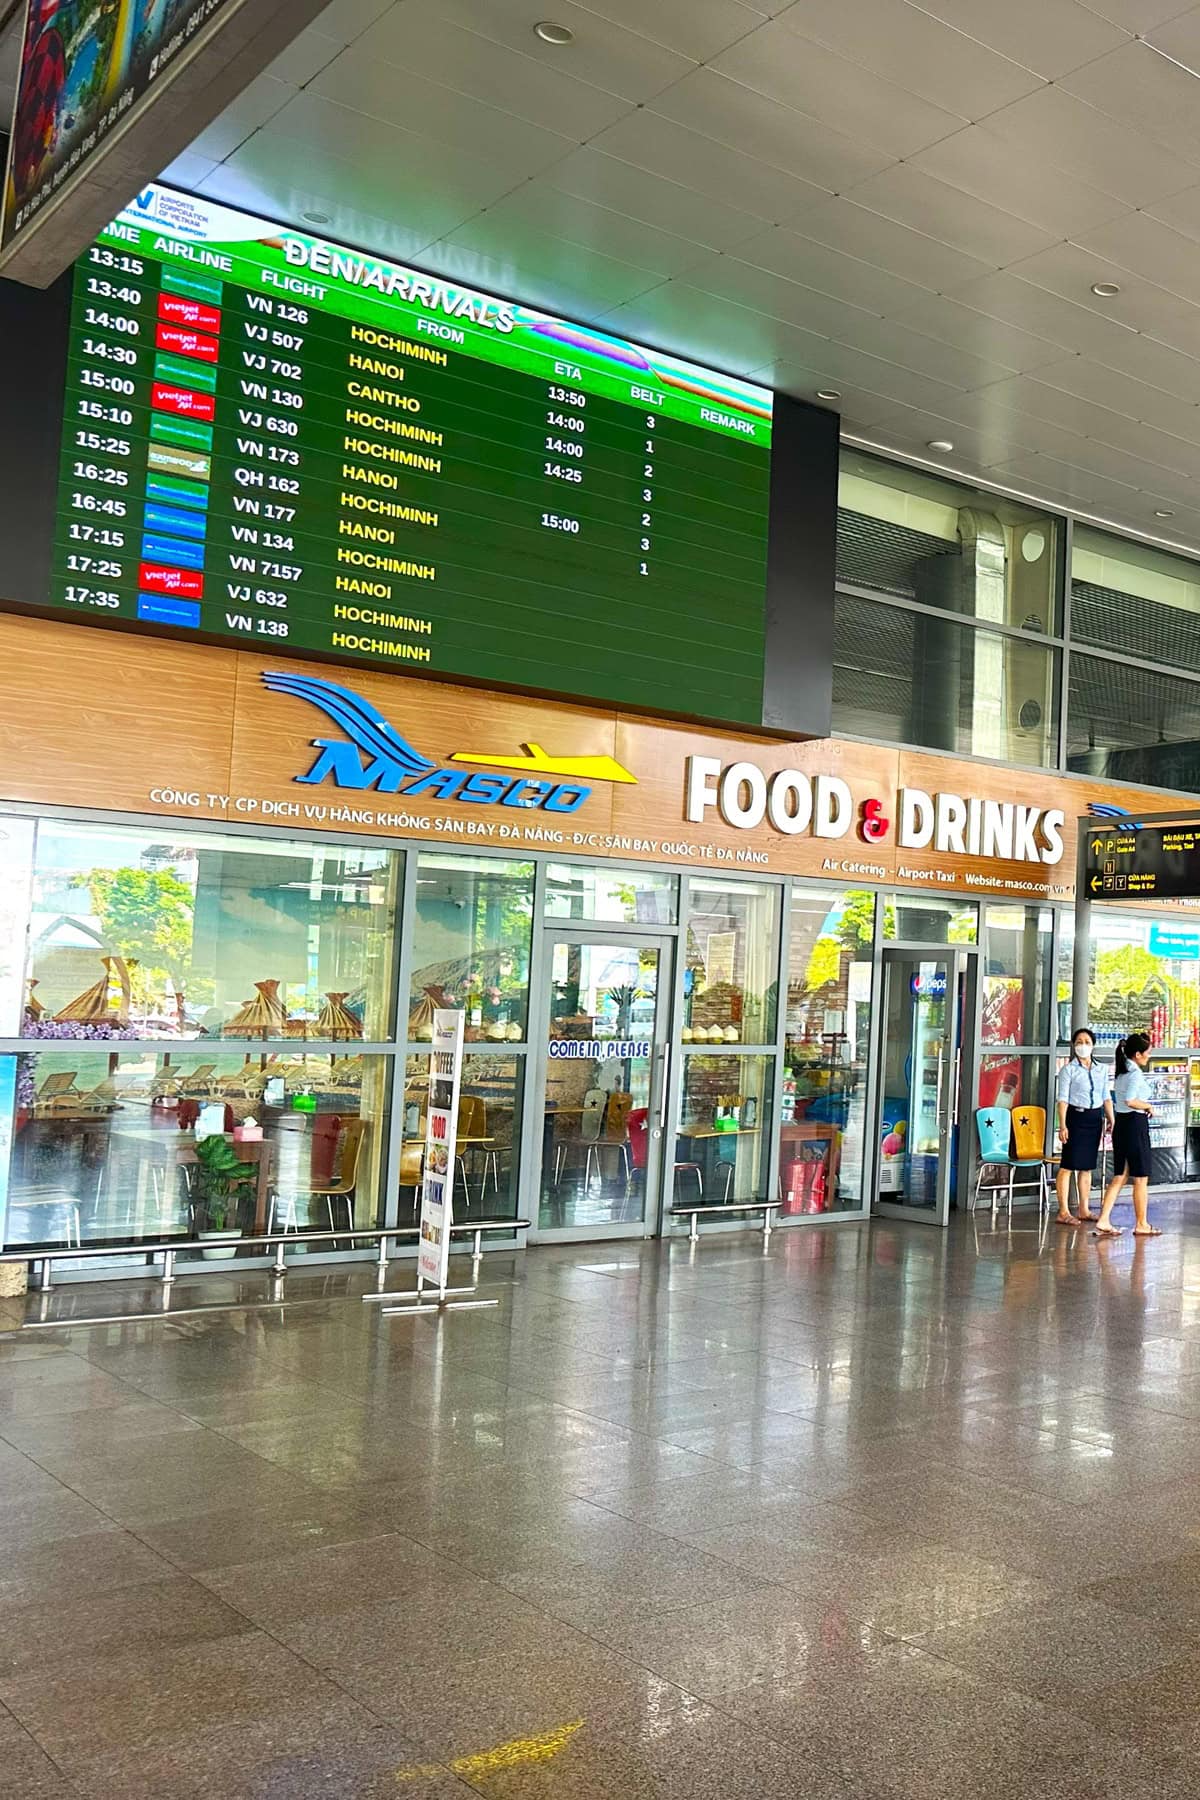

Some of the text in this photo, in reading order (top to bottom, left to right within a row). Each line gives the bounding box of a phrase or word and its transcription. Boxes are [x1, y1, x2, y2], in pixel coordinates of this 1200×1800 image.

[158, 209, 169, 217] OF
[160, 202, 208, 223] CORPORATION
[88, 279, 141, 305] 13:40
[244, 322, 268, 341] VJ
[272, 330, 305, 351] 507
[350, 354, 404, 381] HANOI
[547, 411, 585, 433] 14:00
[645, 440, 654, 454] 1
[90, 248, 655, 429] 13:15 VN 126 HOCHIMINH 13:50 3
[154, 237, 233, 272] AIRLINE
[261, 269, 328, 301] FLIGHT
[416, 317, 465, 345] FROM
[554, 361, 582, 381] ETA
[630, 386, 665, 406] BELT
[699, 408, 756, 436] REMARK
[83, 340, 652, 502] 14:30 VN 130 HOCHIMINH 14:25 3
[86, 309, 653, 478] 14:00 VJ 702 CANTHO 14:00 2
[79, 401, 650, 551] 15:10 VN 173 HANOI 15:00 3
[81, 370, 134, 395] 15:00
[238, 409, 262, 428] VJ
[266, 416, 298, 437] 630
[344, 436, 442, 474] HOCHIMINH
[642, 513, 651, 527] 2
[72, 493, 435, 581] 16:45 VN 134 HOCHIMINH
[74, 463, 395, 545] 16:25 VN 177 HANOI
[76, 432, 130, 456] 15:25
[234, 468, 264, 487] QH
[268, 475, 300, 495] 162
[341, 493, 439, 527] HOCHIMINH
[640, 563, 648, 576] 1
[68, 556, 432, 635] 17:25 VJ 632 HOCHIMINH
[70, 525, 392, 600] 17:15 VN 7157 HANOI
[65, 587, 431, 662] 17:35 VN 138 HOCHIMINH
[150, 786, 200, 806] CÔNG
[206, 793, 231, 809] TY
[235, 798, 258, 812] CP
[261, 800, 300, 817] DỊCH
[303, 805, 327, 821] VỤ
[329, 806, 374, 824] HÀNG
[376, 811, 431, 830] KHÔNG
[434, 816, 464, 832] SÂN
[466, 822, 495, 836] BAY
[604, 834, 631, 850] SÂN
[632, 838, 658, 853] BAY
[686, 754, 1065, 865] FOOD & DRINKS
[822, 858, 839, 870] Air
[841, 860, 886, 878] Catering
[897, 866, 934, 881] Airport
[935, 869, 956, 882] Taxi
[965, 873, 1004, 888] Website:
[549, 1041, 584, 1057] COME
[606, 1040, 650, 1058] PLEASE
